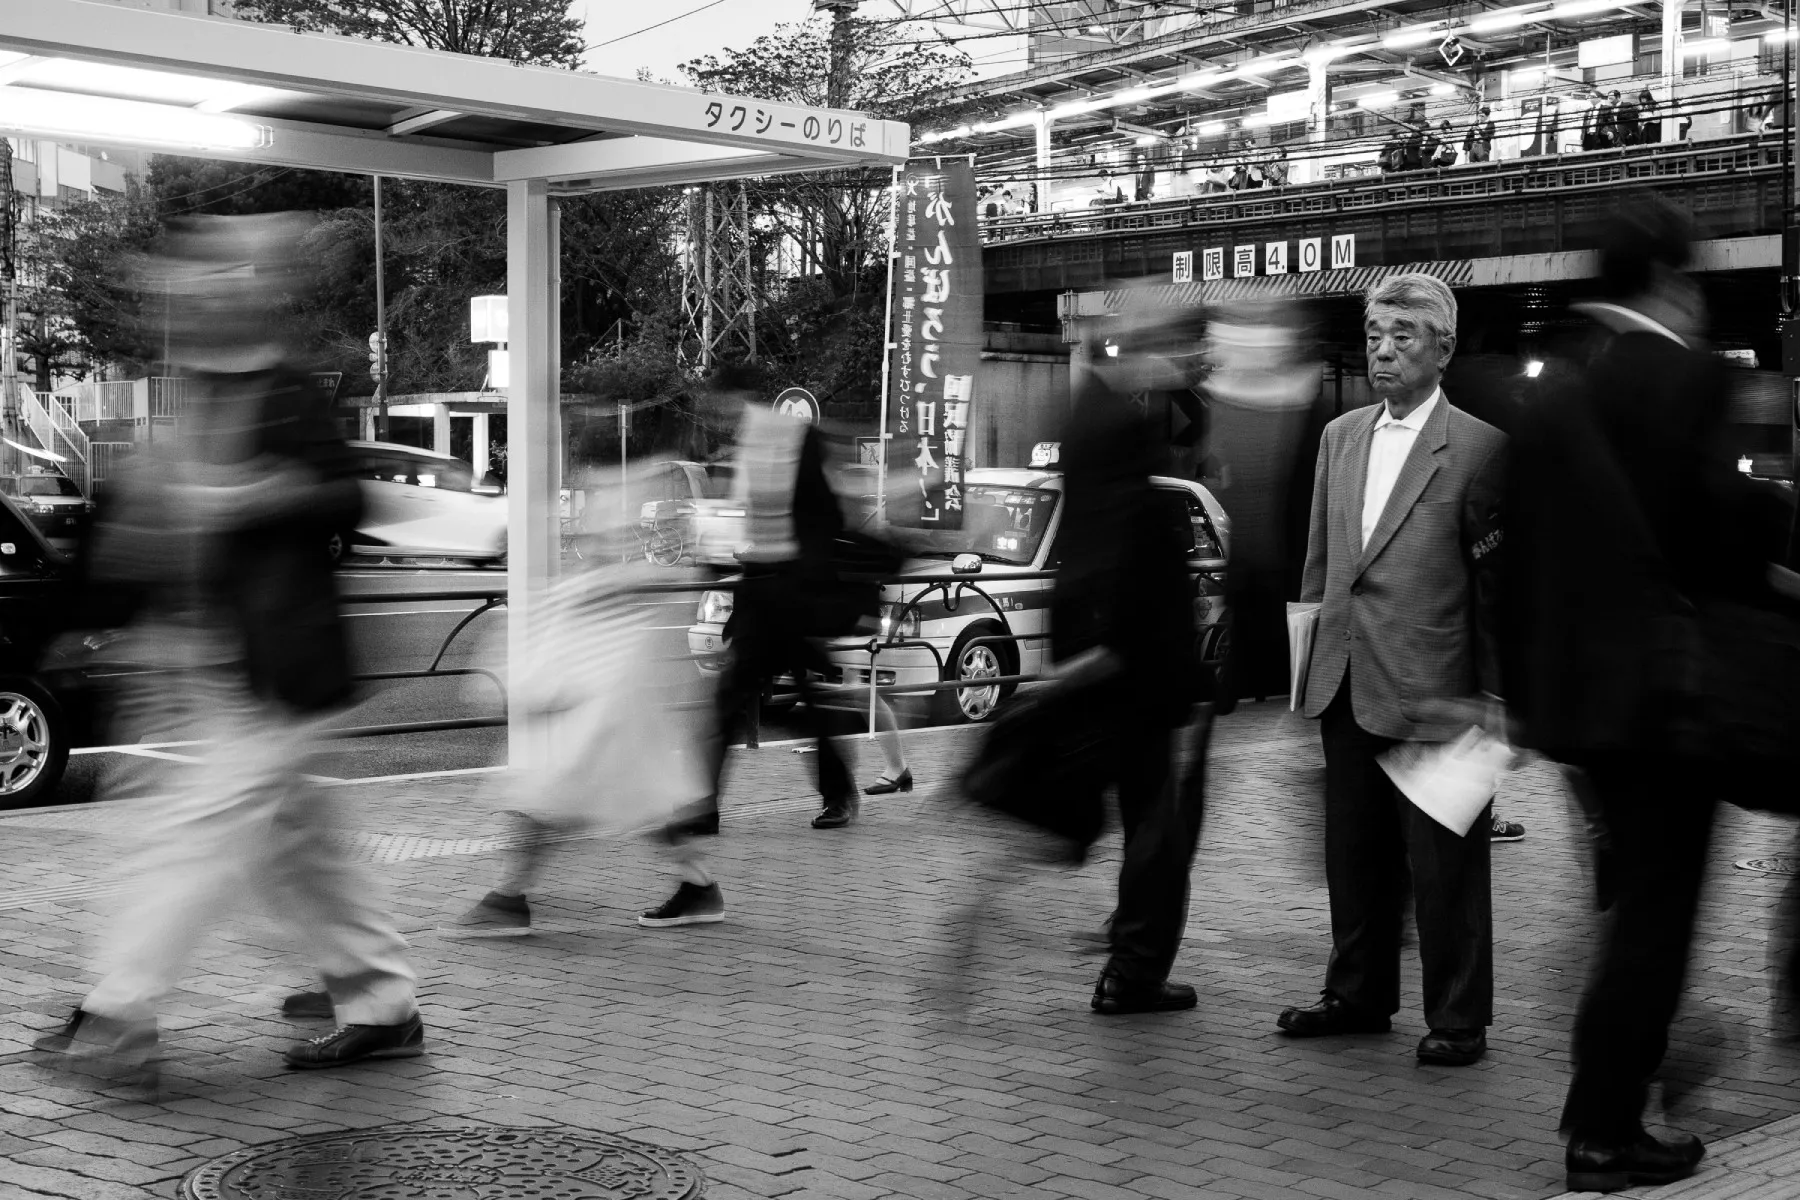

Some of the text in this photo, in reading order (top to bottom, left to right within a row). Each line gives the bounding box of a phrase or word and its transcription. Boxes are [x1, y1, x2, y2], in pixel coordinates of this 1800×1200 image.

[705, 102, 866, 148] タクシーのりば
[1174, 239, 1352, 280] 制限高4.0M
